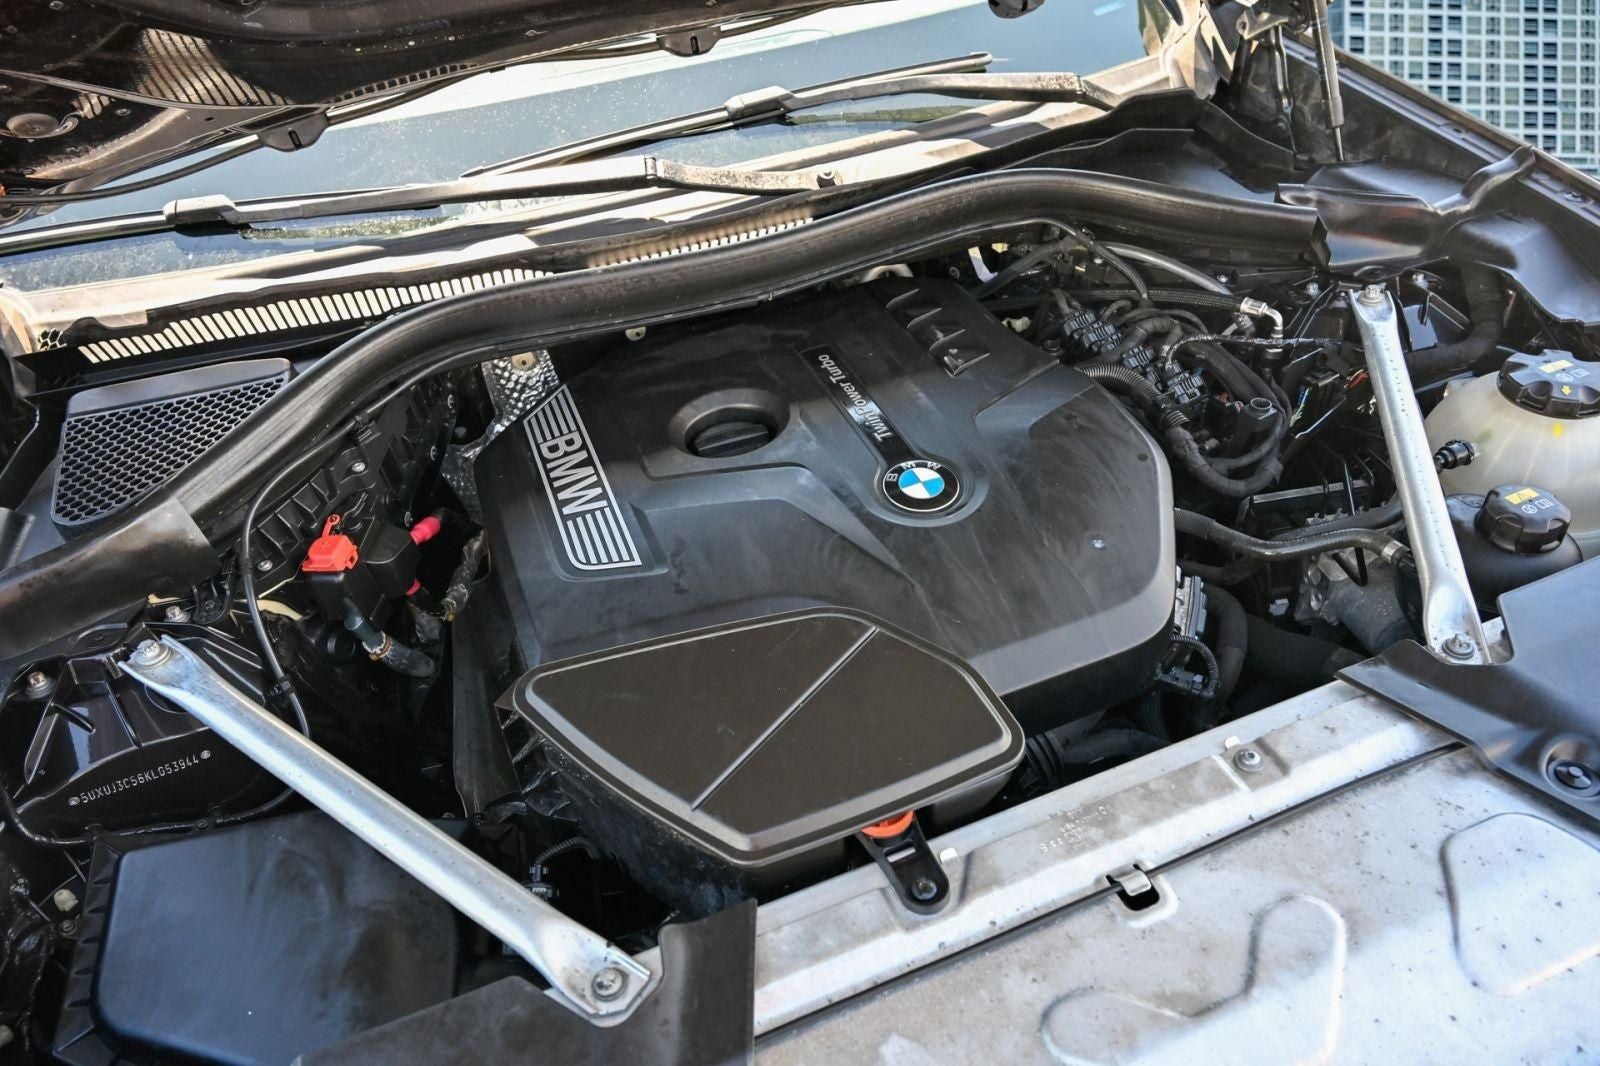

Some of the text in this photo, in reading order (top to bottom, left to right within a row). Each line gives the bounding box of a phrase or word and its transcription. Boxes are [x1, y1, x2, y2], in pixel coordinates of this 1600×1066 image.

[818, 354, 892, 442] TwinPower Turbo
[539, 430, 609, 515] BMW
[886, 461, 942, 482] BMW
